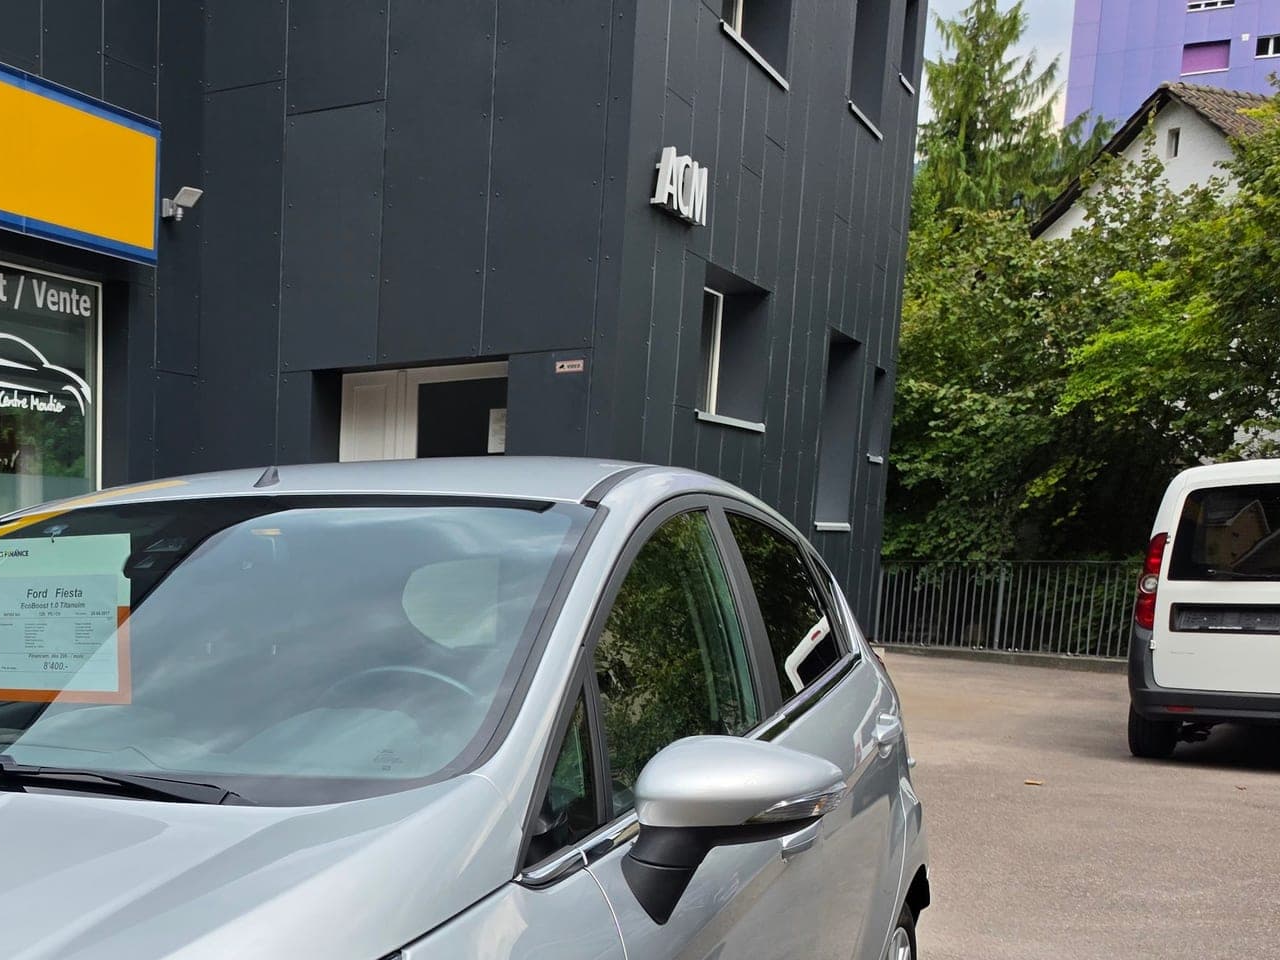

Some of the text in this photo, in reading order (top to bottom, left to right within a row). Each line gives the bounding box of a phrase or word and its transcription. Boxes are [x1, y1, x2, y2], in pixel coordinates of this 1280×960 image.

[654, 146, 709, 227] ACM
[32, 279, 91, 317] Vente
[30, 392, 65, 413] Moutier
[26, 588, 83, 599] Ford Fiesta
[20, 602, 49, 610] EcoBoost
